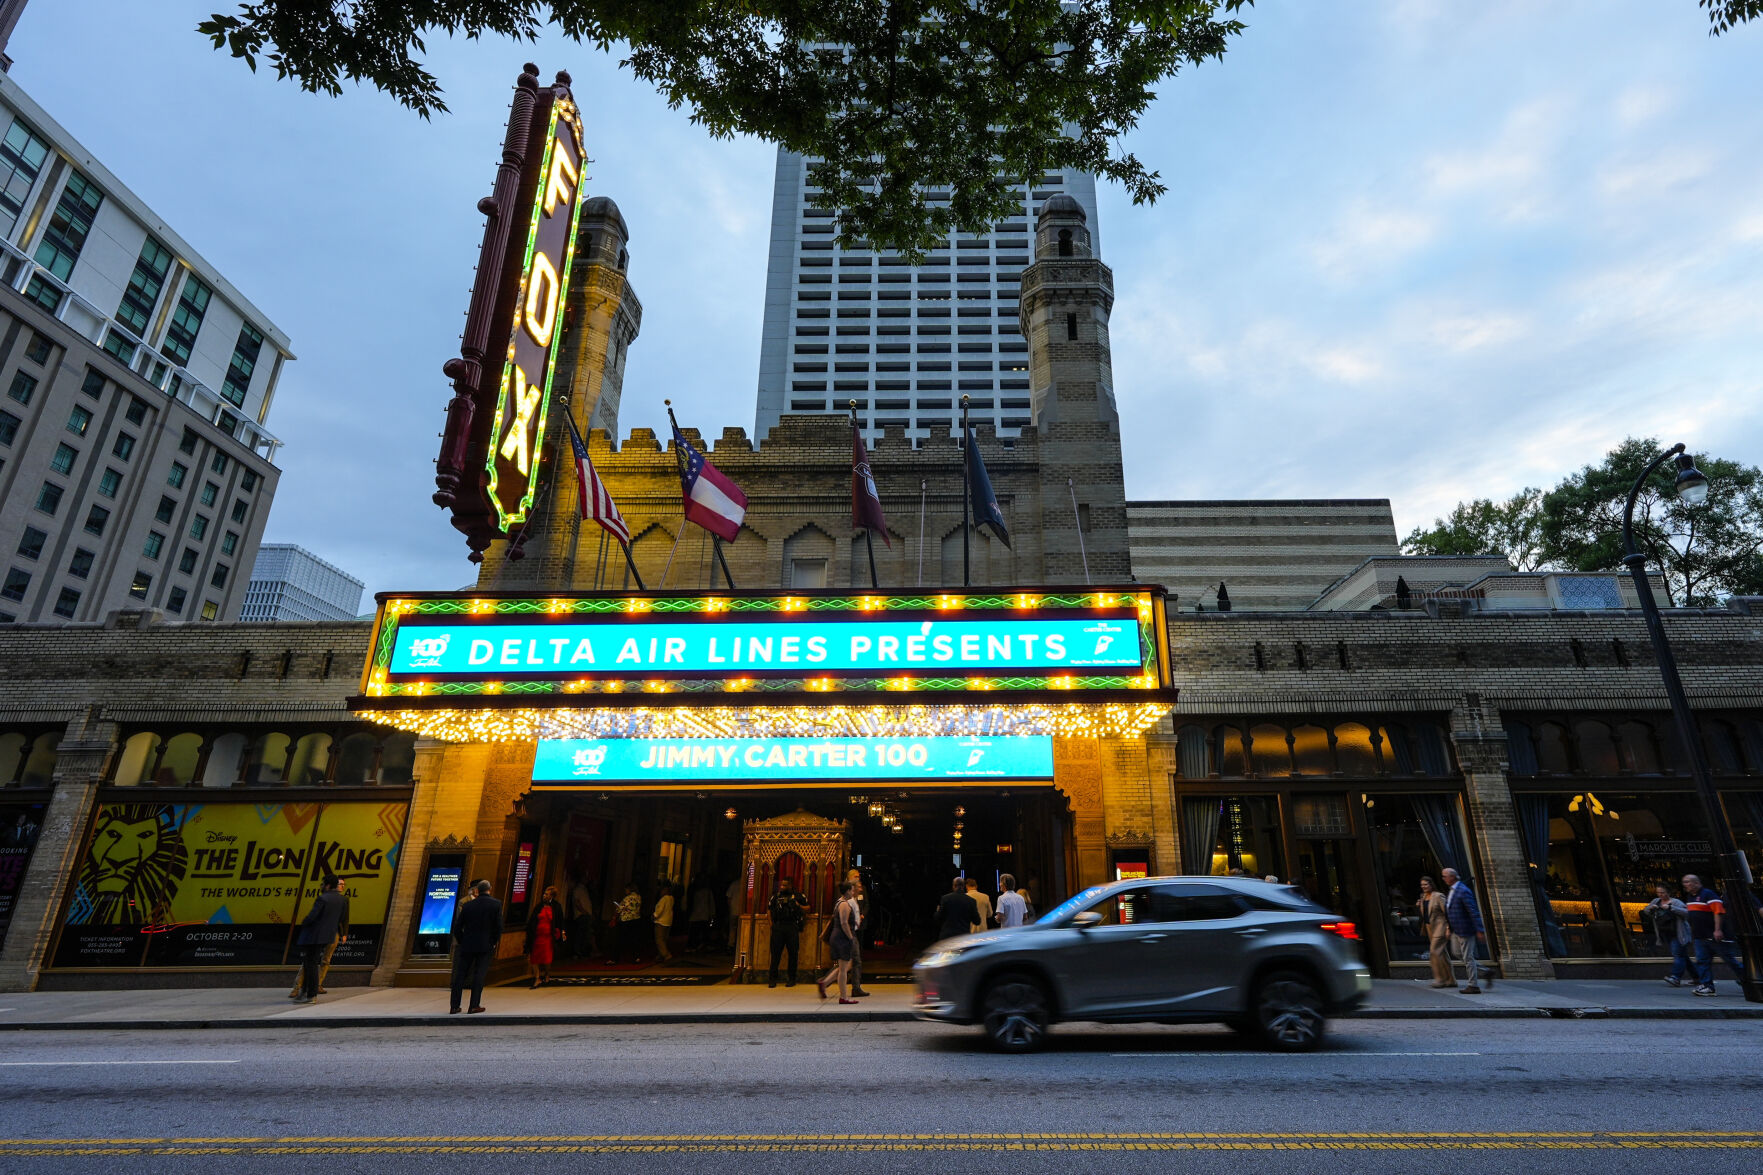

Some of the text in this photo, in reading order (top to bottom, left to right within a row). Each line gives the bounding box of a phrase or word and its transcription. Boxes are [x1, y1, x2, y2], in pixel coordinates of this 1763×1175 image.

[500, 137, 578, 477] FOX
[467, 638, 596, 665] DELTA
[615, 638, 687, 664] AIR
[707, 636, 828, 663] LINES
[850, 634, 1067, 662] PRESENTS
[640, 744, 928, 768] JIMMY CARTER 100
[1640, 843, 1712, 852] MARQUEE CLUB
[193, 840, 383, 881] THE LION KING
[200, 888, 223, 898] THE
[227, 887, 281, 897] WORLD'S
[284, 887, 299, 897] #1
[186, 932, 253, 941] OCTOBER 2-20
